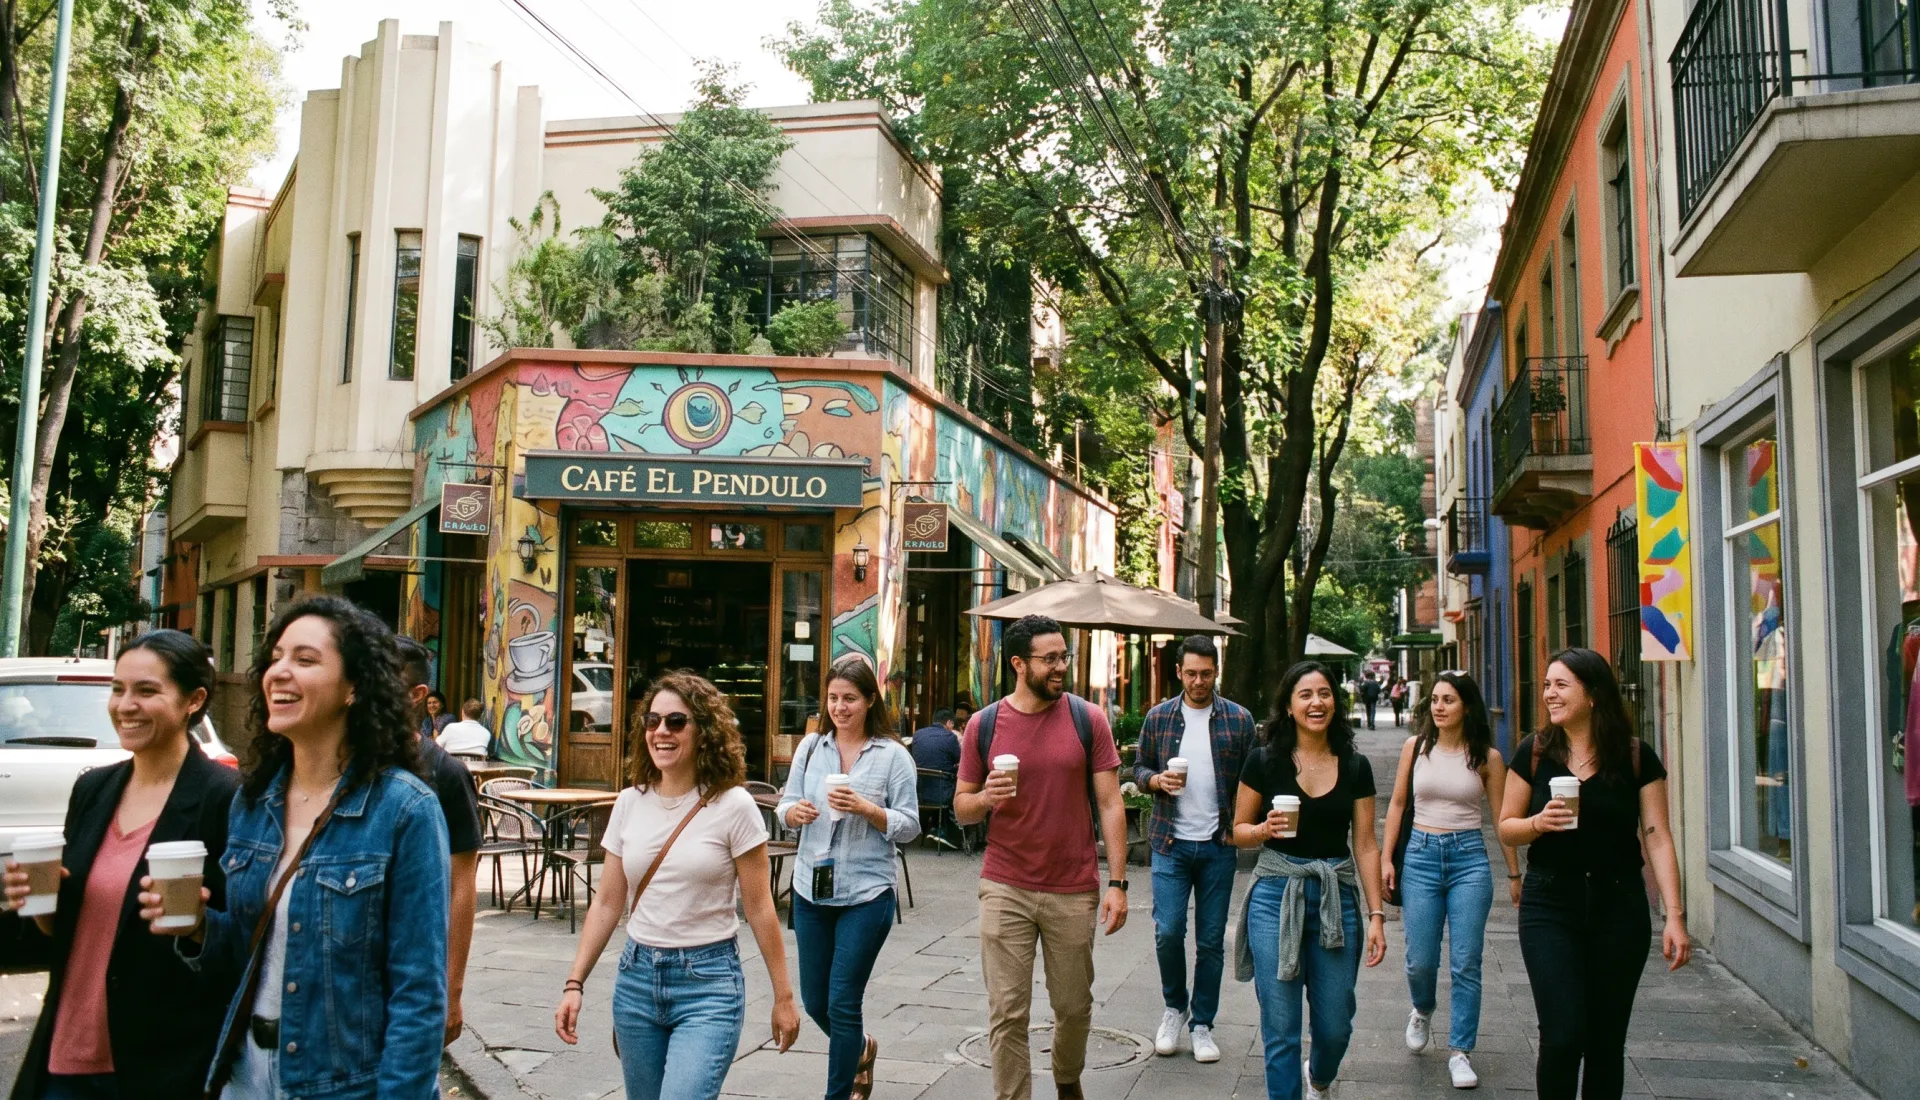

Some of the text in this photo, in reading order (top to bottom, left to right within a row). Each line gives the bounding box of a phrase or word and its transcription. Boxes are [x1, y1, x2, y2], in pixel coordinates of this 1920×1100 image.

[561, 465, 827, 498] CAFÉ EL PENDULO
